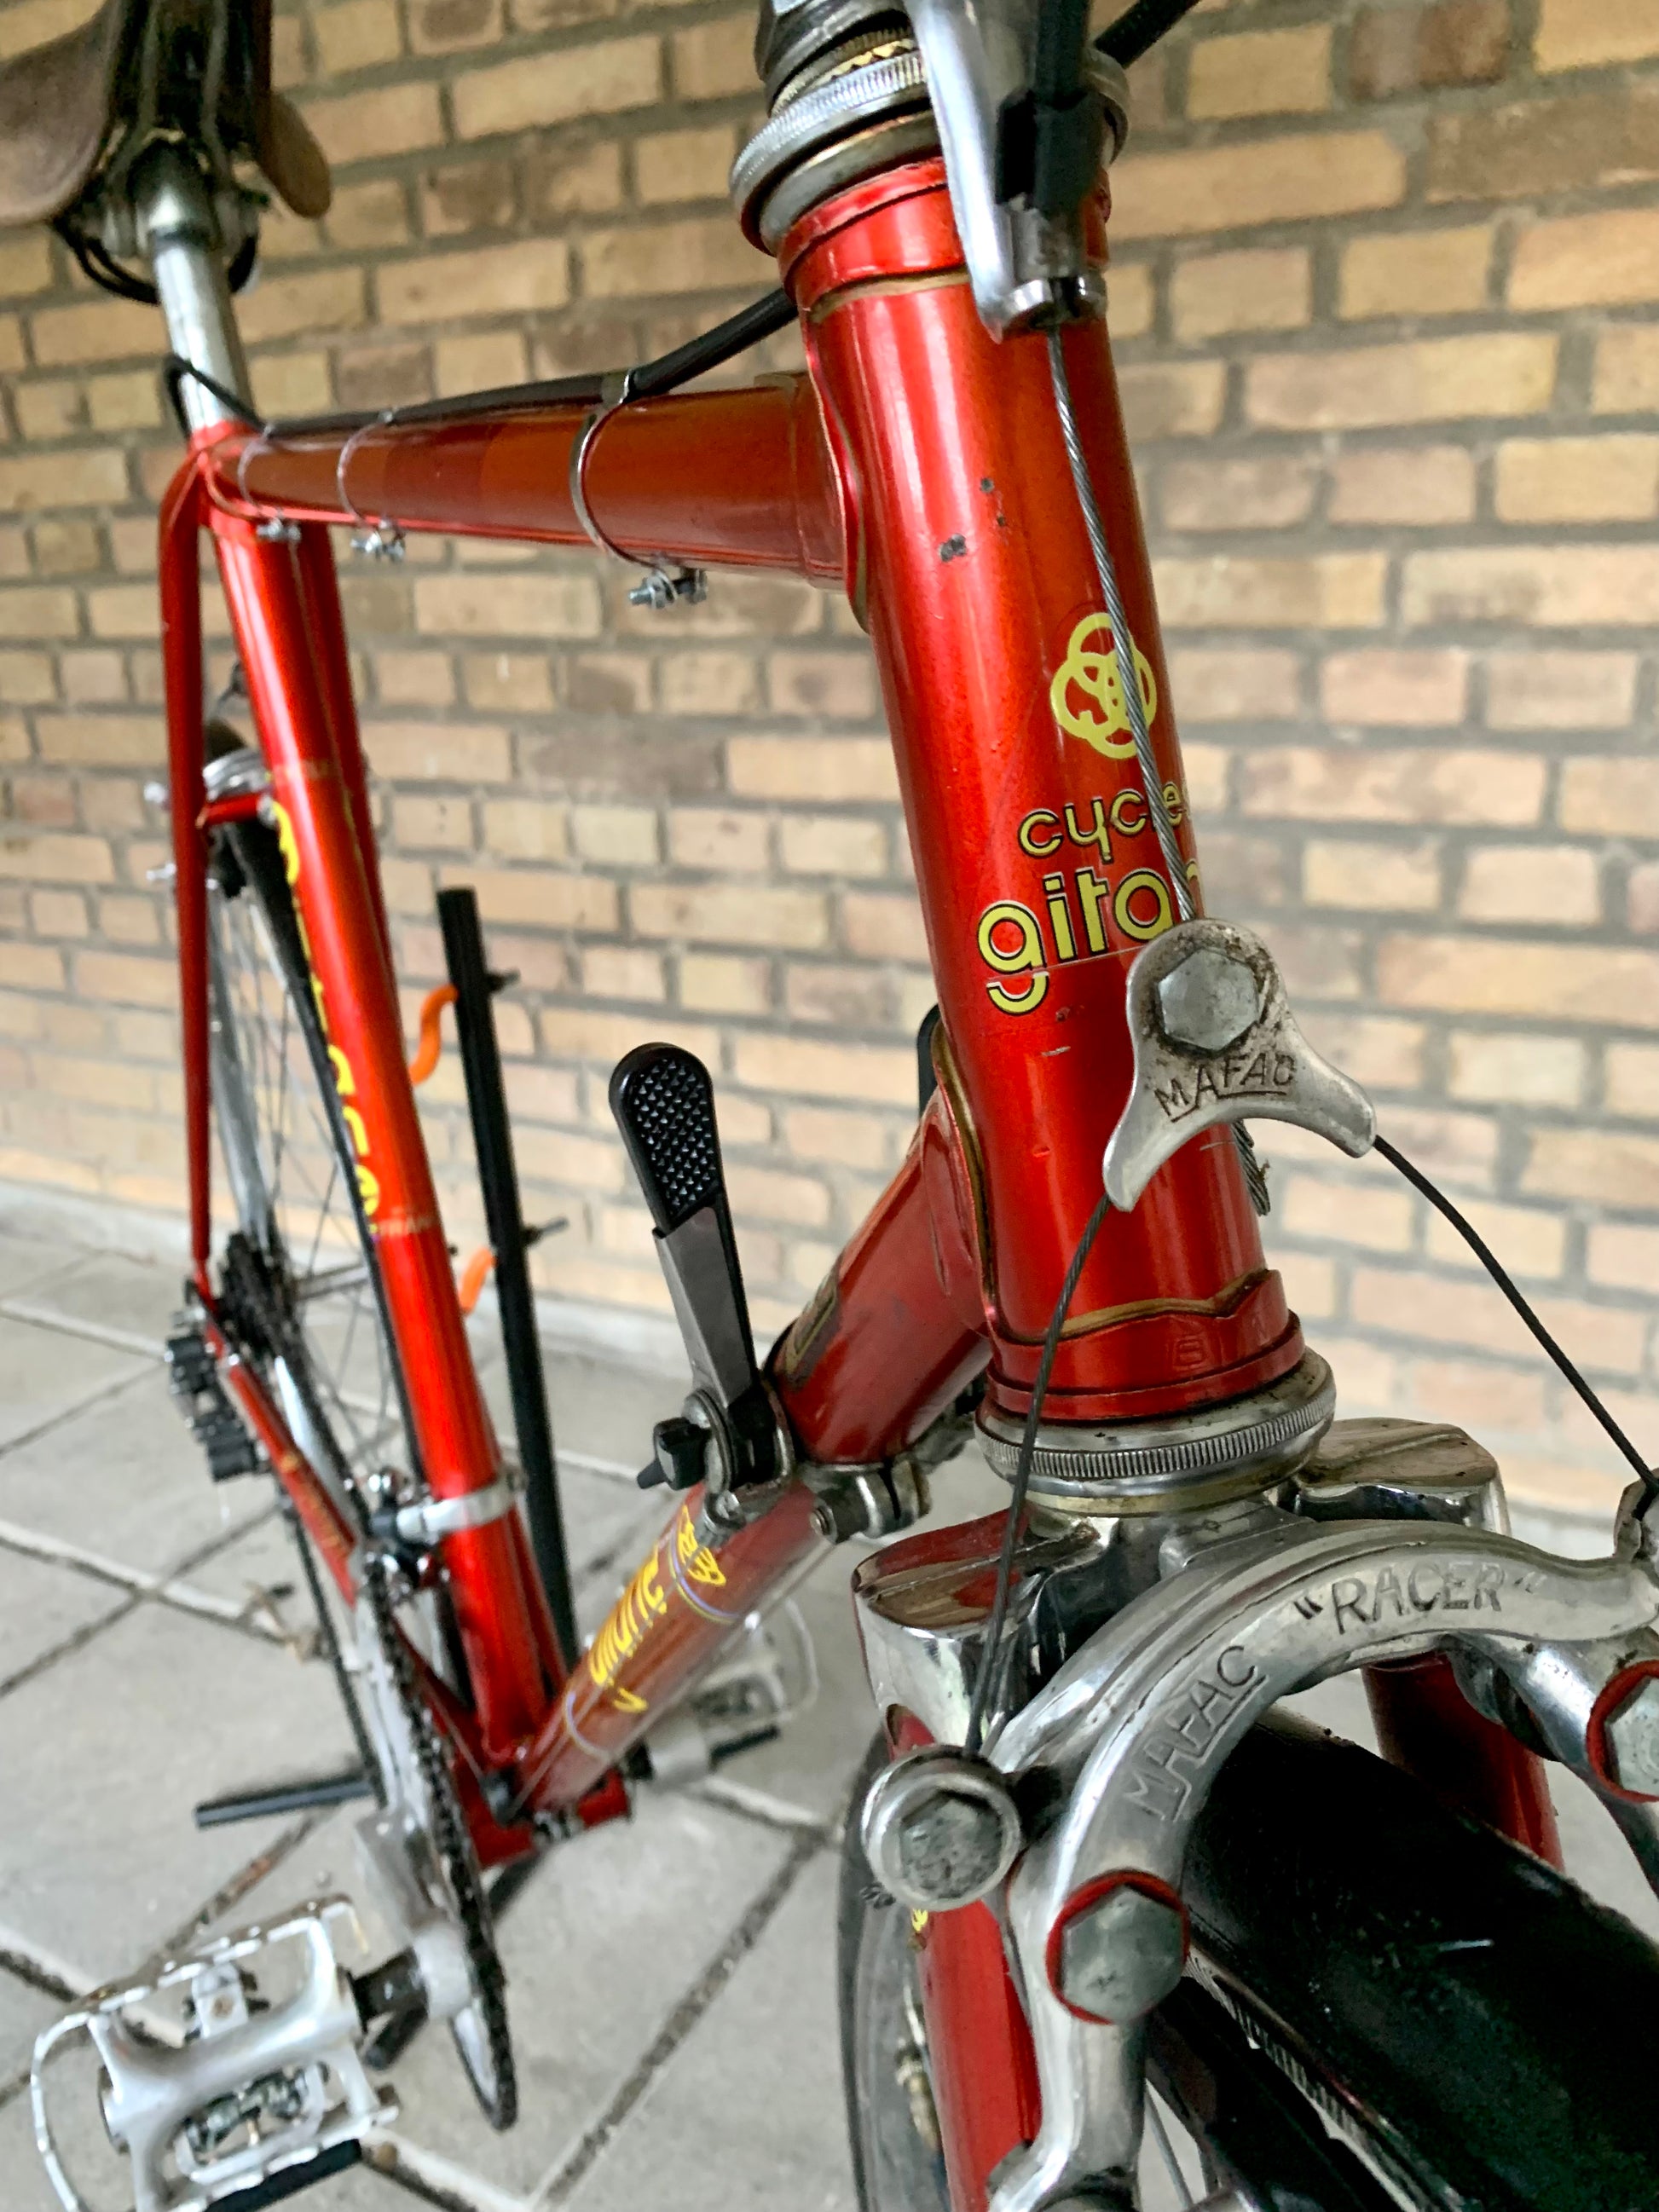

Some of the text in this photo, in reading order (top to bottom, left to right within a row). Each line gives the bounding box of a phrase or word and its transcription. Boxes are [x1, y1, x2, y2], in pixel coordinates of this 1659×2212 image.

[1018, 781, 1186, 863] cyce
[1154, 1052, 1295, 1122] MAFAC
[1122, 1645, 1269, 1822] MAFAC
